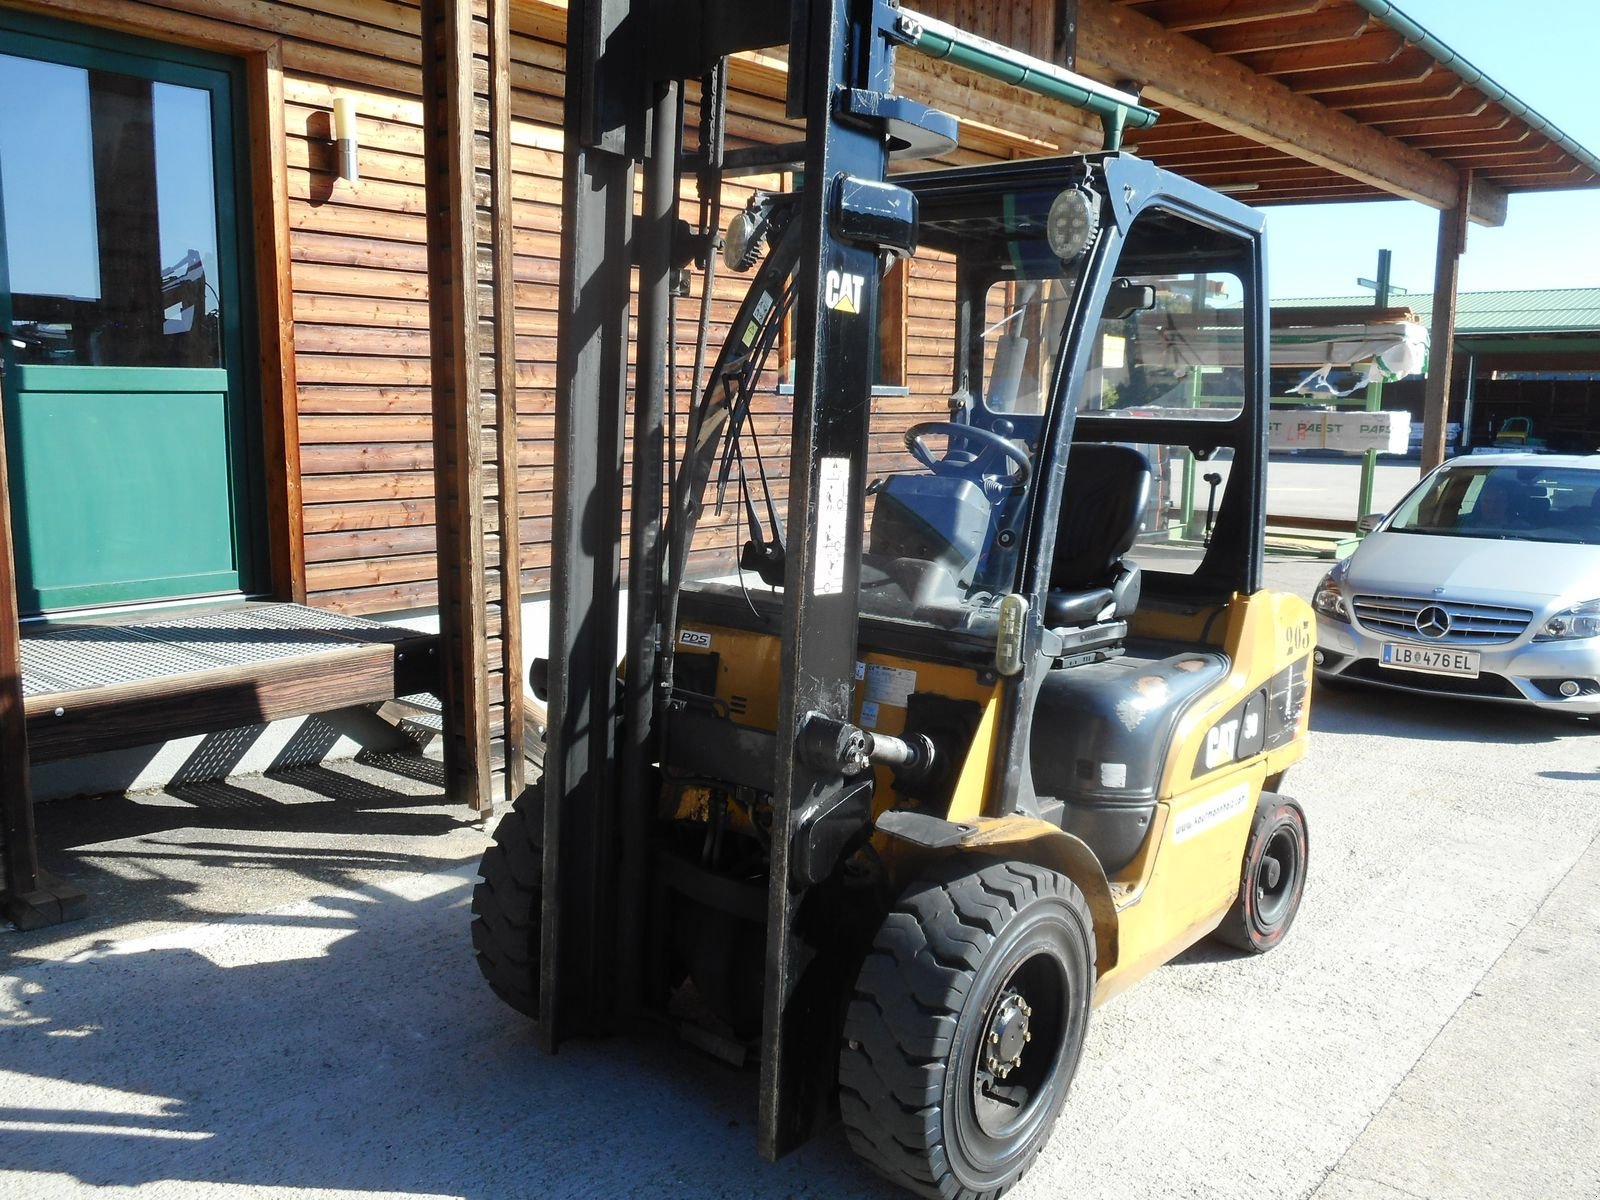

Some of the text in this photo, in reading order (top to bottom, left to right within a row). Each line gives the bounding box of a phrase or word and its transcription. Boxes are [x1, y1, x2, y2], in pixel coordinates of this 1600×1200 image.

[825, 270, 865, 315] CAT
[681, 632, 709, 643] PDS
[1395, 648, 1472, 670] LB 476 EL
[1205, 720, 1238, 769] CAT
